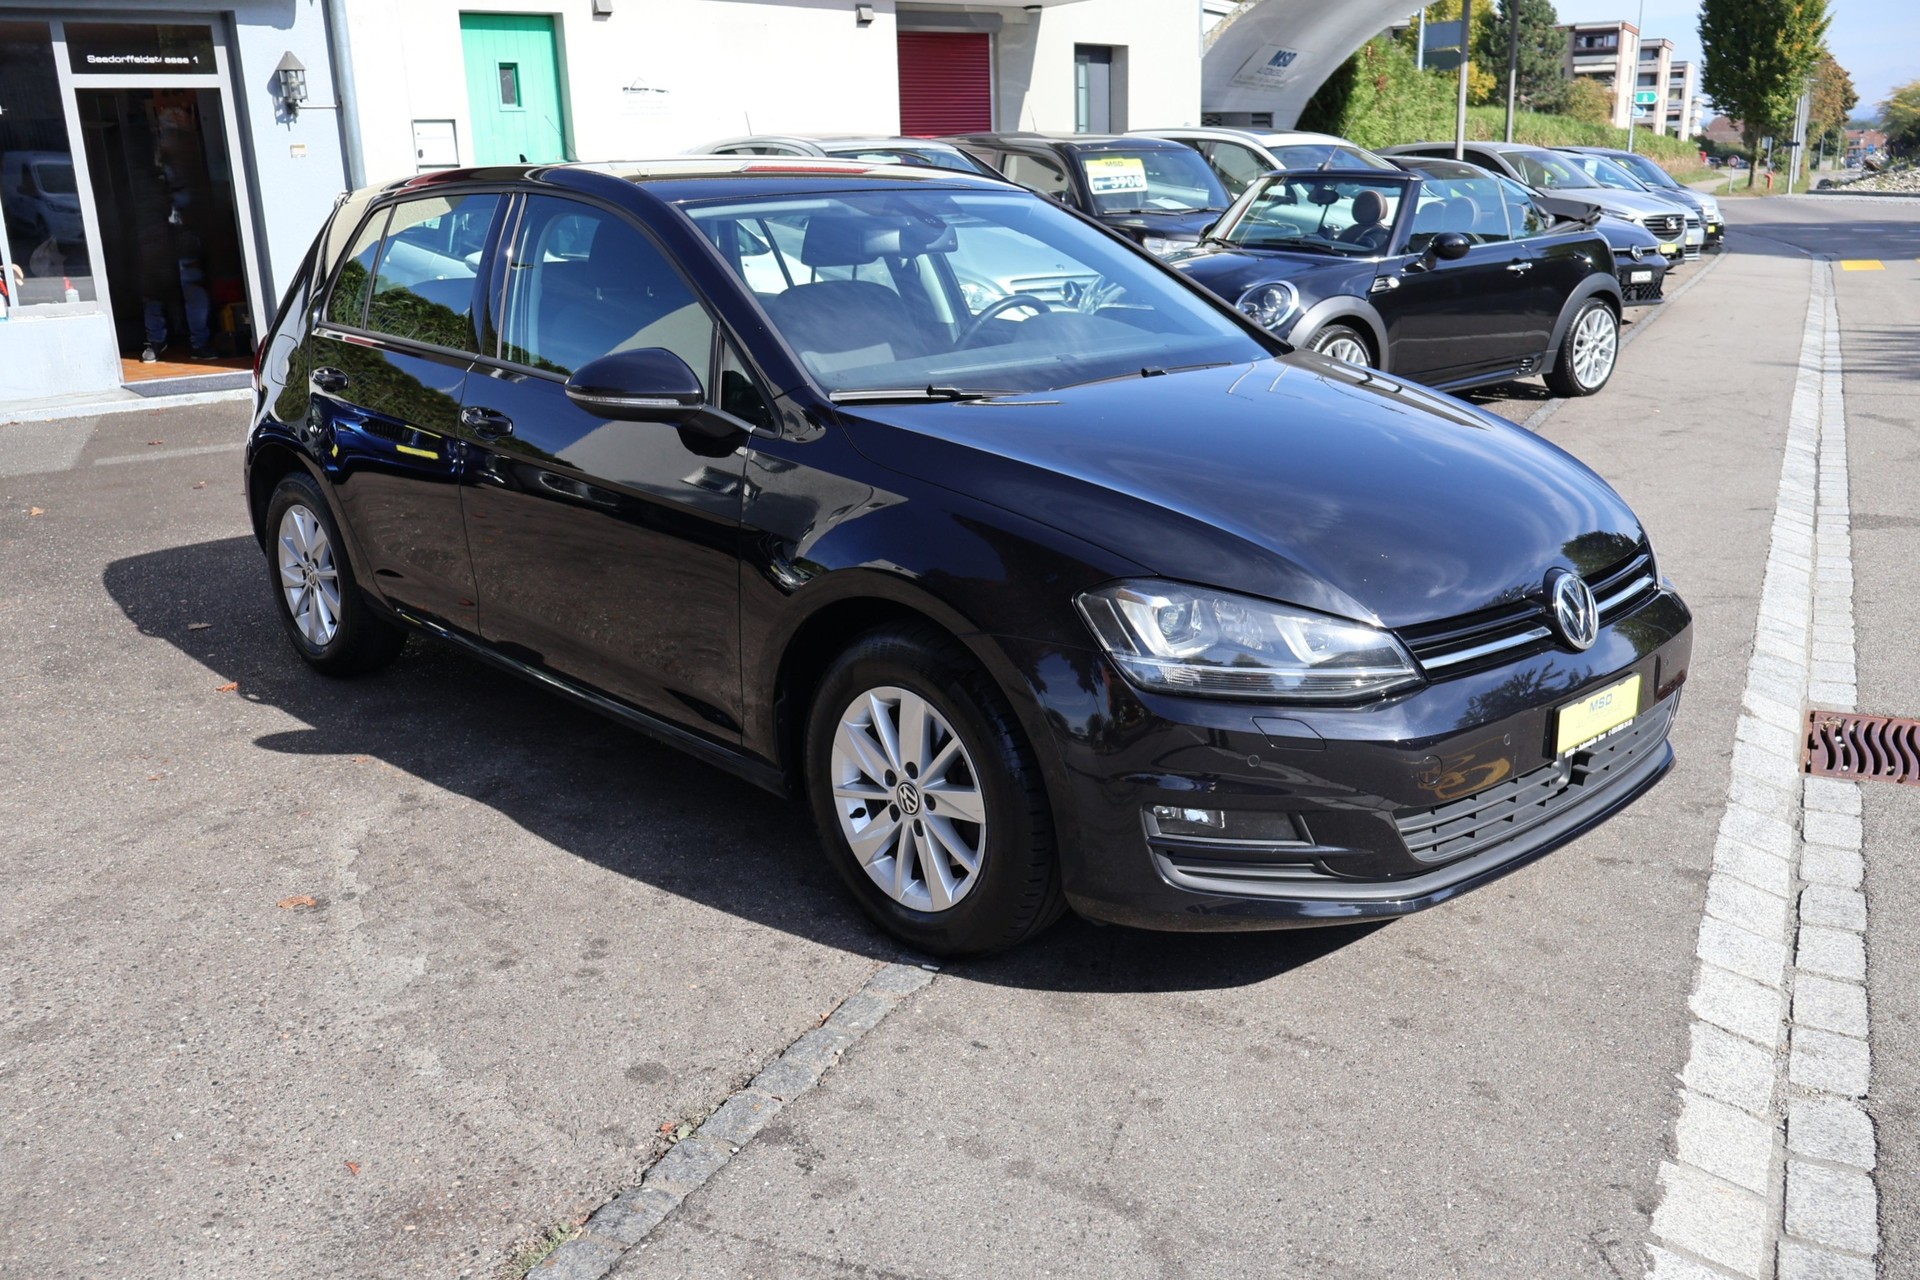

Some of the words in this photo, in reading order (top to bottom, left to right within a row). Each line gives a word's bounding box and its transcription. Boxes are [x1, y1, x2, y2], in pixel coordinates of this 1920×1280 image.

[192, 55, 199, 64] 1
[1267, 49, 1298, 68] MSD
[1105, 160, 1124, 168] MSD
[1589, 692, 1613, 714] MSD
